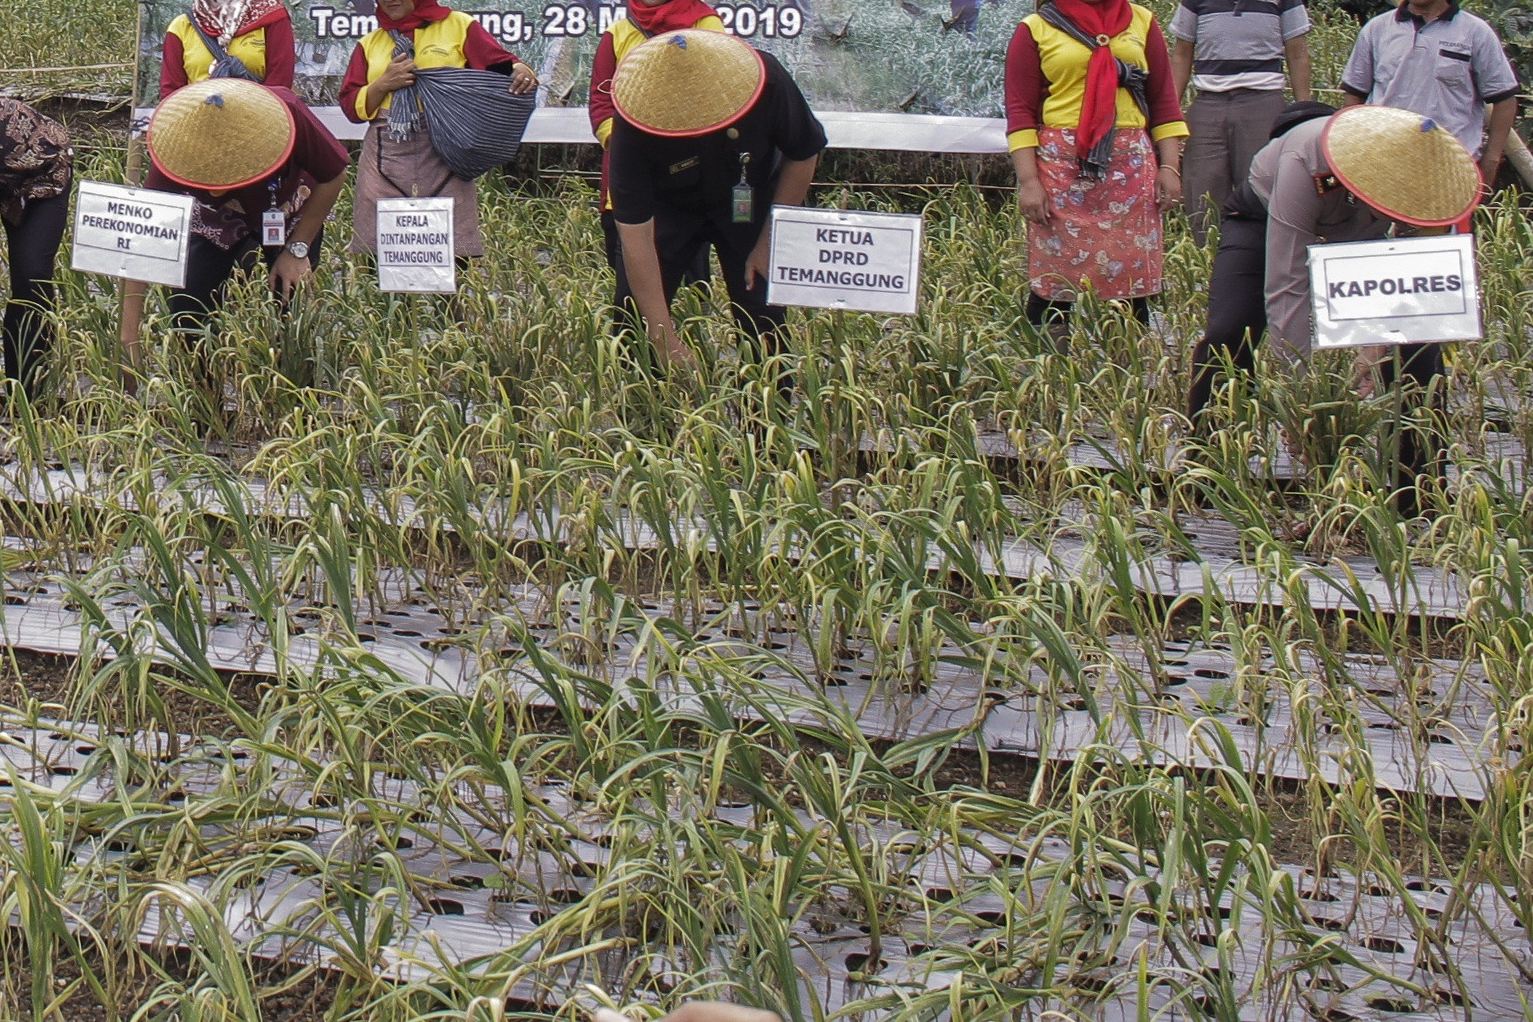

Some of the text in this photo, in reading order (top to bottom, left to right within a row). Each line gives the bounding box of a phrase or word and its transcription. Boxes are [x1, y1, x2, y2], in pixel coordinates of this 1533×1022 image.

[544, 6, 587, 35] 28
[716, 6, 801, 37] 2019
[107, 201, 153, 220] MENKO
[82, 214, 179, 241] PEREKONOMIAN
[395, 215, 429, 228] KEPALA
[117, 237, 131, 250] RI
[380, 232, 449, 245] DINTANPANGAN
[816, 228, 875, 246] KETUA
[383, 250, 443, 263] TEMANGGUNG
[818, 249, 869, 266] DPRD
[777, 266, 904, 289] TEMANGGUNG
[1328, 274, 1461, 299] KAPOLRES
